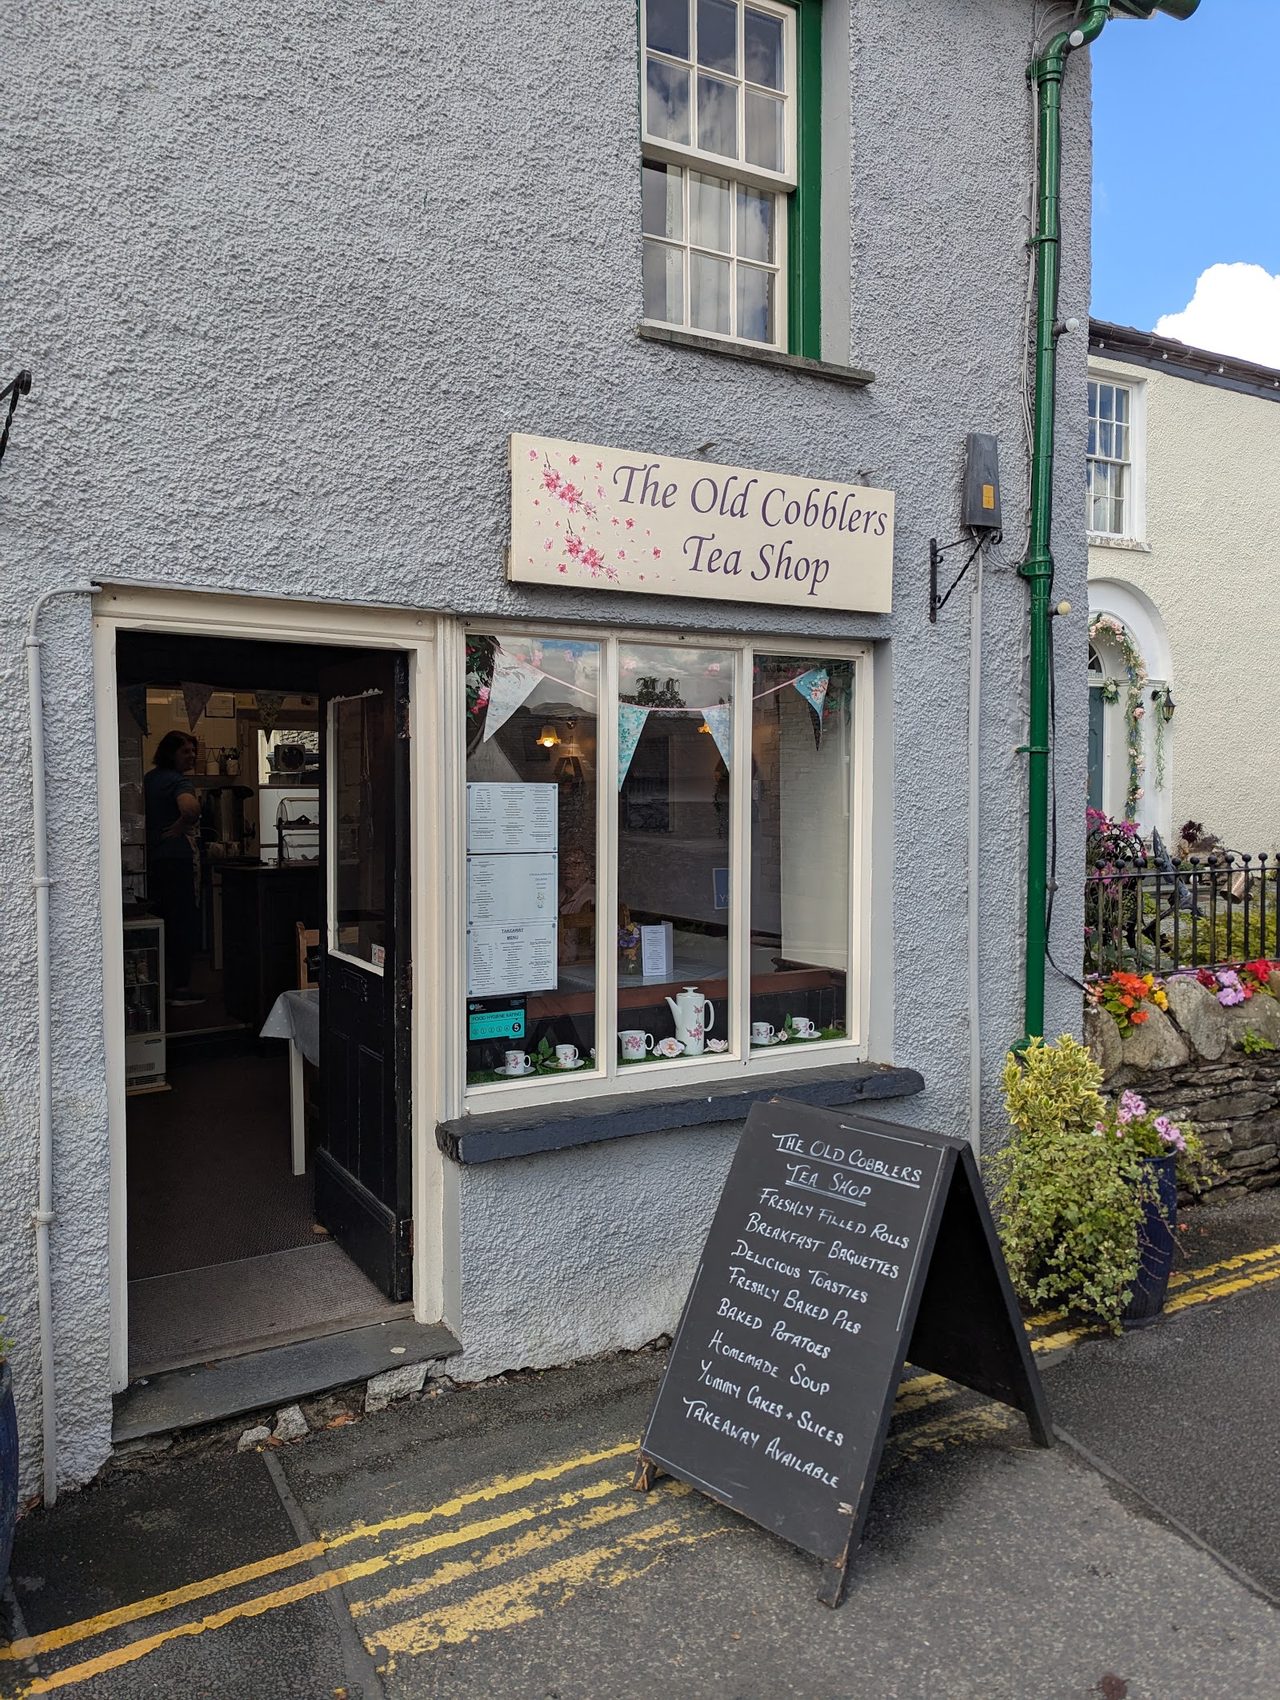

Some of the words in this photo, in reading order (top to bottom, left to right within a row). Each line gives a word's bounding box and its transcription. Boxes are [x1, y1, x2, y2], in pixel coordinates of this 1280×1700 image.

[613, 463, 677, 509] The
[691, 475, 759, 519] Old
[761, 487, 888, 536] Cobblers
[683, 533, 742, 575] Tea
[751, 540, 830, 596] Shop
[513, 1023, 519, 1031] 5
[772, 1133, 804, 1153] THE
[810, 1140, 845, 1161] OLD
[849, 1149, 922, 1182] COBBLERS
[787, 1163, 819, 1187] TEA
[829, 1172, 871, 1198] SHOP
[745, 1212, 825, 1252] BREAKFAST
[828, 1240, 900, 1279] BAGUETTES
[759, 1188, 813, 1218] FRESHLY
[818, 1208, 867, 1234] FILLED
[870, 1223, 910, 1249] ROLLS
[728, 1266, 779, 1302] FRESHLY
[783, 1289, 829, 1320] BAKED
[832, 1310, 861, 1334] PIES
[731, 1239, 800, 1278] DELICIOUS
[808, 1269, 868, 1303] TOASTIES
[717, 1298, 762, 1330] BAKED
[770, 1321, 831, 1359] POTATOES
[708, 1329, 779, 1378] HOMEMADE
[790, 1363, 830, 1395] SOUP
[698, 1359, 741, 1398] YUMMY
[747, 1385, 783, 1418] CAKES
[786, 1411, 793, 1420] +
[797, 1411, 844, 1446] SLICES
[683, 1396, 760, 1448] TAKEAWAY
[765, 1437, 839, 1488] AVAILABLE
